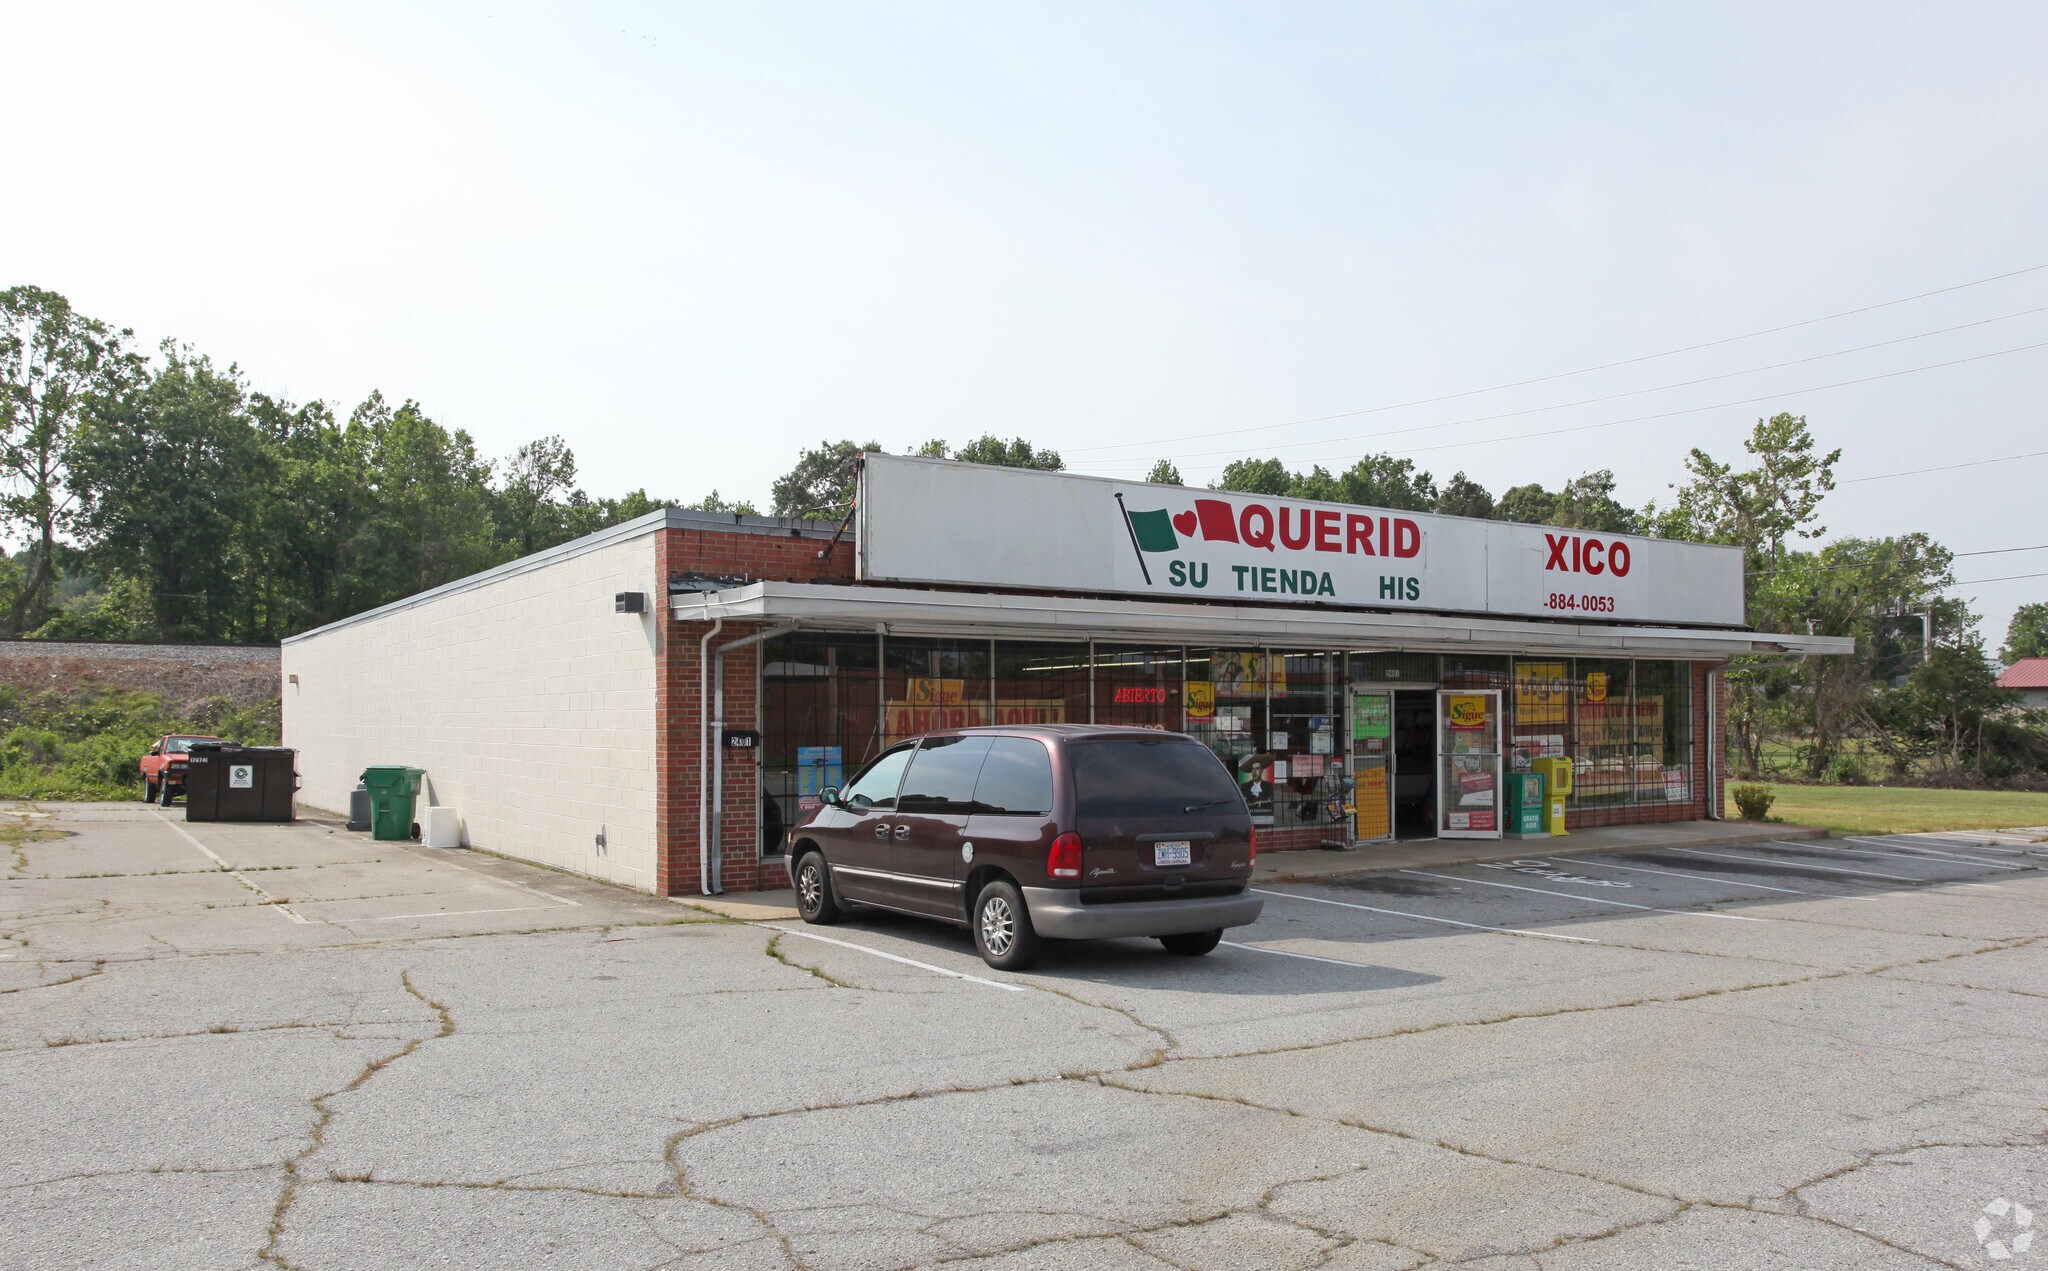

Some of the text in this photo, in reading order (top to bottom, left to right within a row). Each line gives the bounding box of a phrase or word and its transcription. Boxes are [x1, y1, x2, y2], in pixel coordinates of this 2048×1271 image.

[1239, 503, 1421, 559] QUERID
[1544, 533, 1631, 578] XICO
[1168, 559, 1421, 601] SU TIENDA HIS
[1113, 687, 1167, 703] ABIERTO
[1188, 691, 1214, 712] Sigue
[1451, 703, 1484, 722] Sigue
